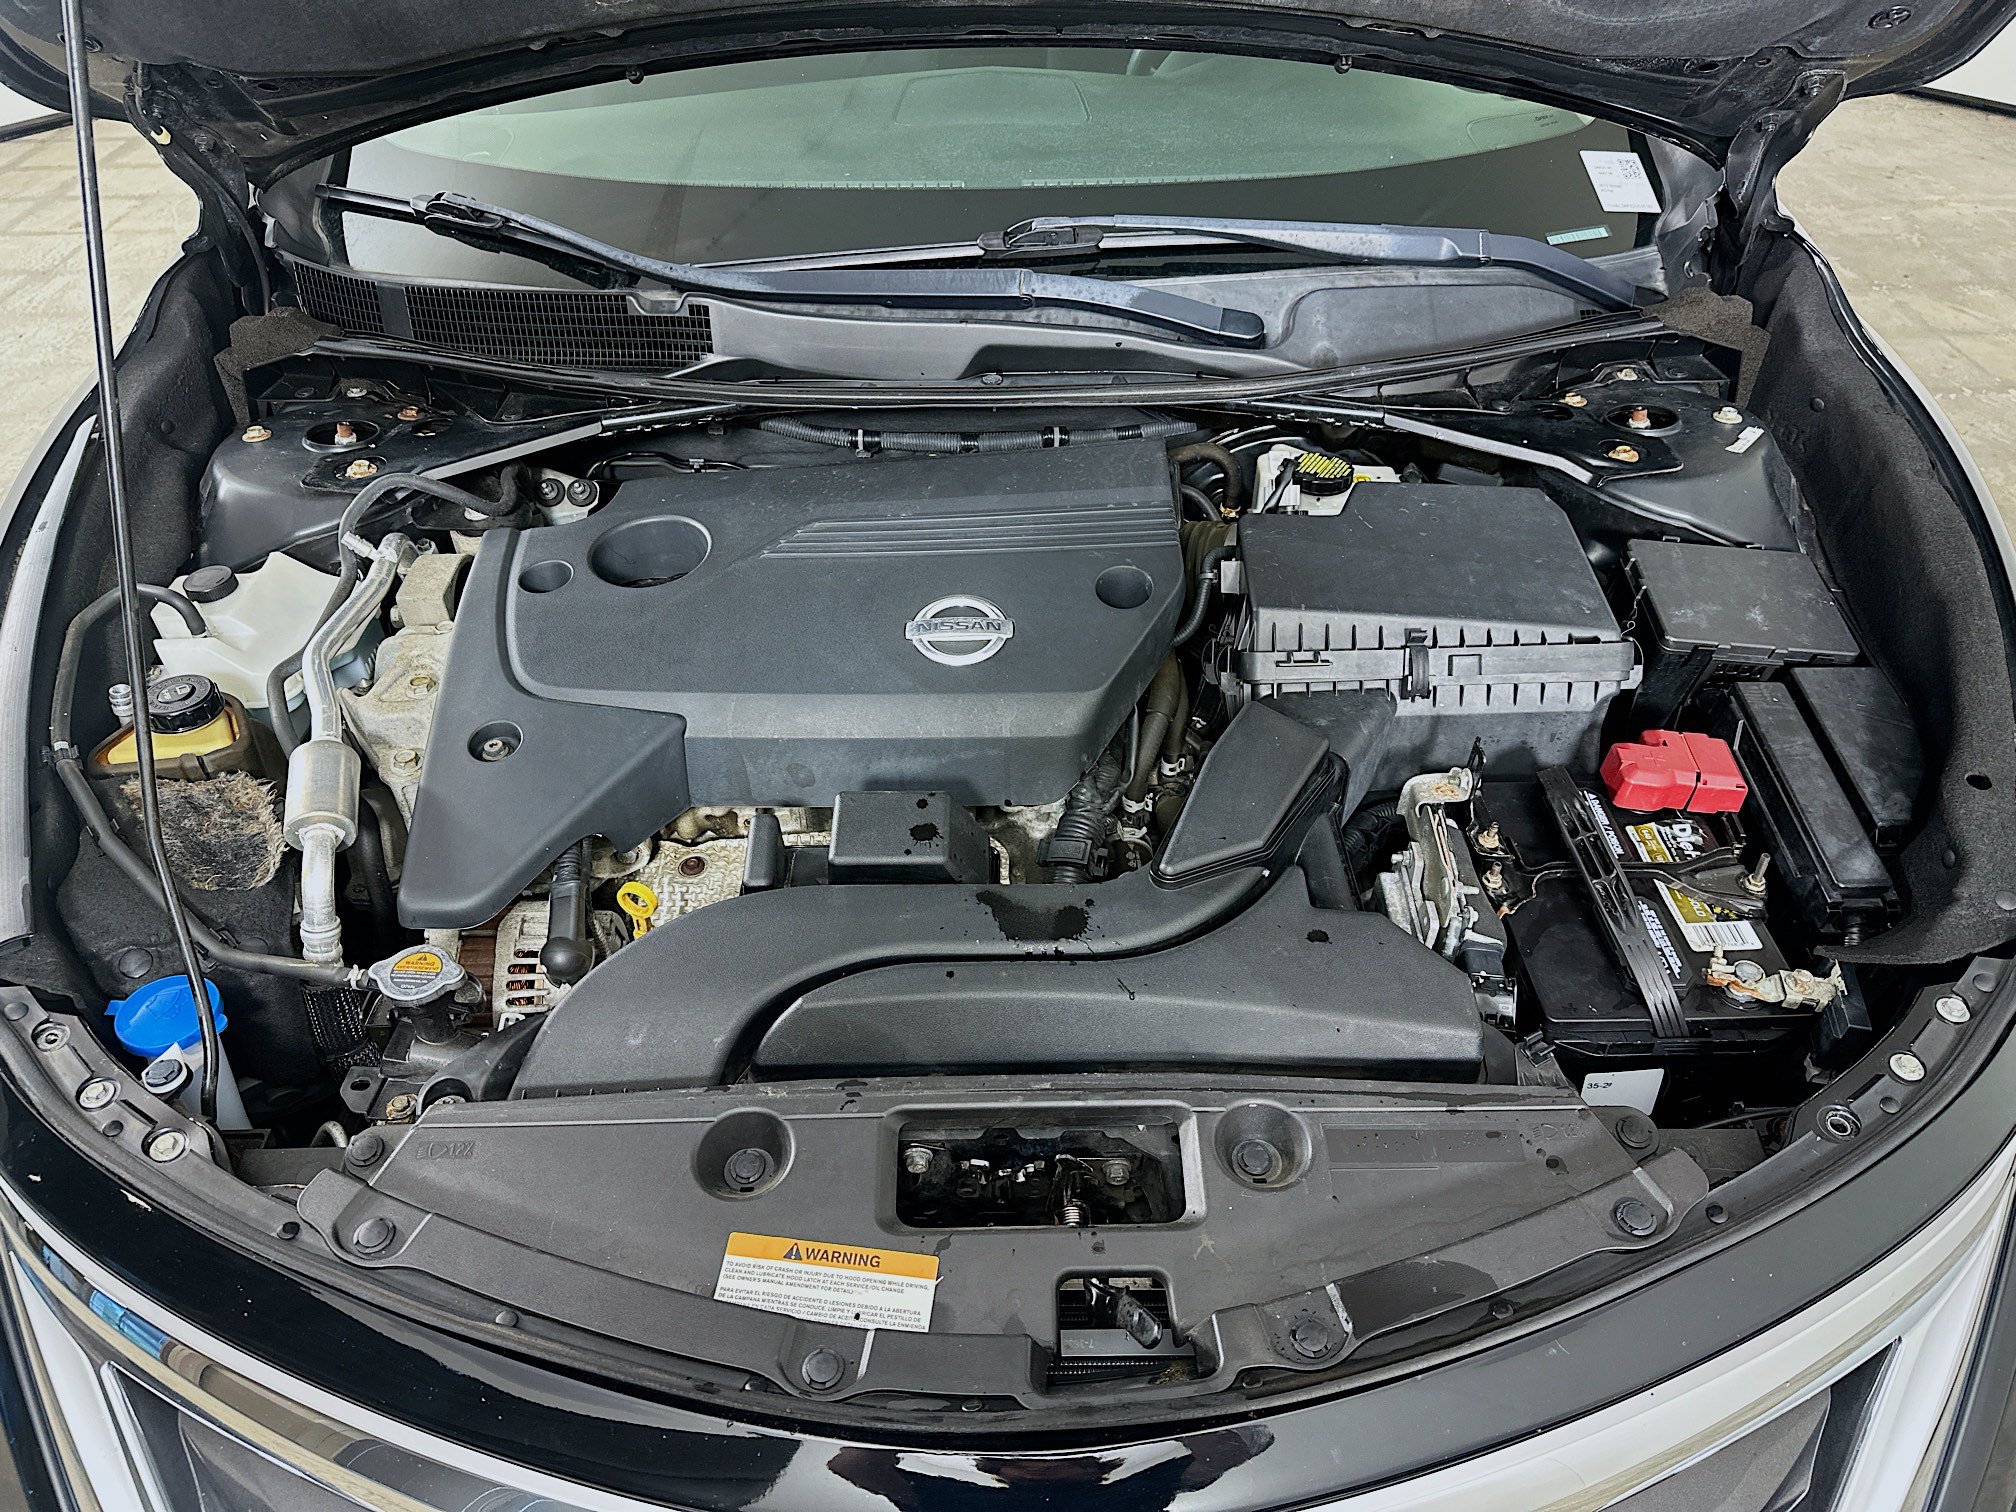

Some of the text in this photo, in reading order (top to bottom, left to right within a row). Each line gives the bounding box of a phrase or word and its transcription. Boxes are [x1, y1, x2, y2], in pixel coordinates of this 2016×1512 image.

[918, 620, 1002, 632] NISSAN
[806, 1248, 881, 1268] WARNING
[785, 1281, 819, 1290] AMENDMENT
[792, 1295, 822, 1304] ACCIDENTE
[892, 1307, 921, 1315] ABERTURA
